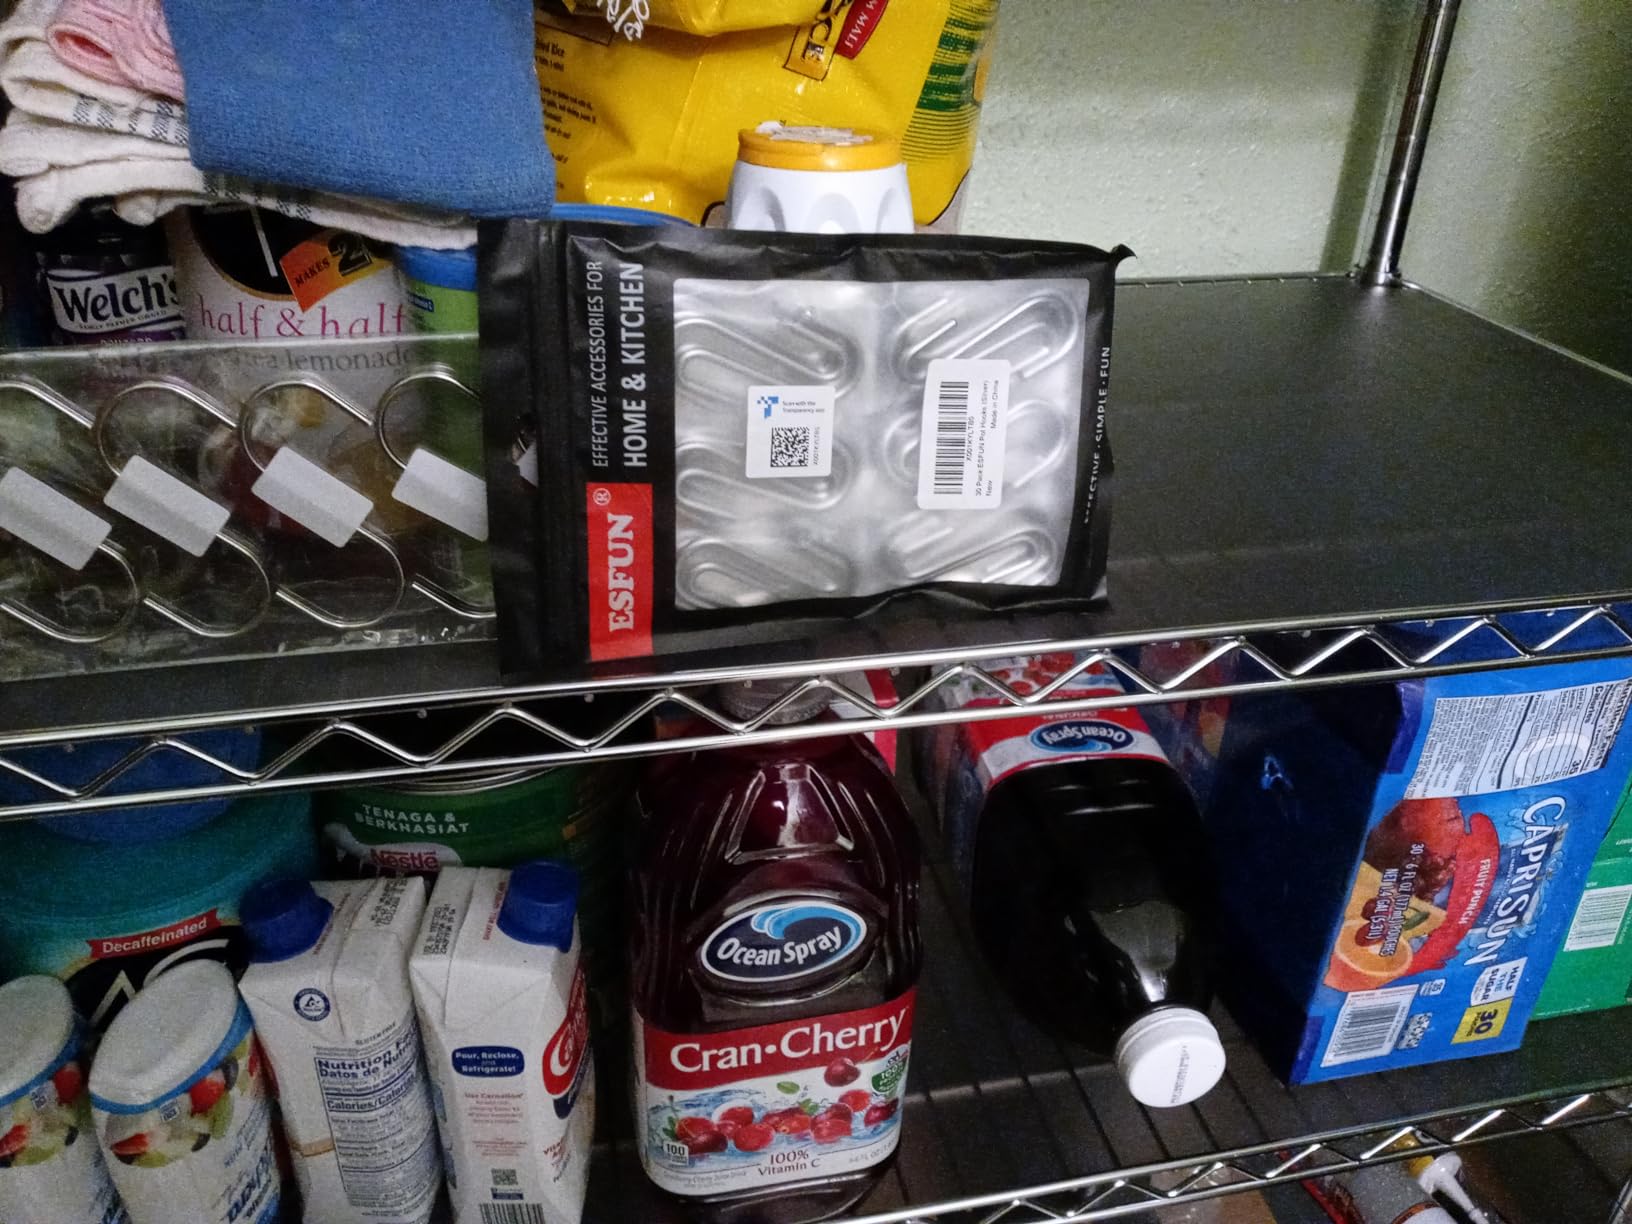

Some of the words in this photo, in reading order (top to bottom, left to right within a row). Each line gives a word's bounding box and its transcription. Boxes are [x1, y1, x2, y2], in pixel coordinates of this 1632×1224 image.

[294, 257, 331, 287] MAKES
[328, 233, 373, 276] 2
[586, 261, 604, 290] FOR
[53, 273, 178, 322] Welch's
[199, 294, 265, 338] half
[276, 307, 304, 337] &
[320, 302, 407, 337] half
[619, 263, 646, 364] KITCHEN
[587, 295, 607, 393] ACCESSORIES
[1100, 346, 1110, 378] FUN
[621, 373, 647, 391] &
[591, 396, 609, 467] EFFECTIVE
[990, 410, 998, 429] Made
[622, 399, 648, 467] HOME
[977, 443, 985, 468] ESFUN
[985, 480, 993, 497] New
[607, 512, 635, 632] ESFUN
[1584, 685, 1604, 724] Calories
[1041, 725, 1082, 745] Spray
[1082, 725, 1126, 742] Ocean
[1569, 760, 1581, 775] 35
[354, 811, 469, 834] BERKHASIAT
[362, 803, 436, 823] TENAGA
[444, 812, 456, 823] &
[1410, 843, 1424, 855] 30
[1383, 868, 1399, 883] NET
[1401, 871, 1417, 880] FL
[1475, 858, 1491, 888] FRUIT
[1374, 899, 1391, 914] GAL
[1458, 889, 1484, 925] PUNCH
[102, 916, 208, 954] Decaffeinated
[717, 937, 781, 966] Ocean
[783, 926, 843, 965] Spray
[1481, 967, 1500, 1001] SUGAR
[1505, 965, 1520, 991] HALF
[1474, 1009, 1498, 1035] 30
[318, 1050, 392, 1070] Nutrition
[320, 1068, 358, 1079] Datos
[363, 1066, 380, 1077] de
[461, 1065, 516, 1074] Refrigerate!
[666, 1143, 685, 1156] 100
[770, 1149, 809, 1165] 100%
[757, 1162, 807, 1177] Vitamin
[811, 1158, 821, 1168] C
